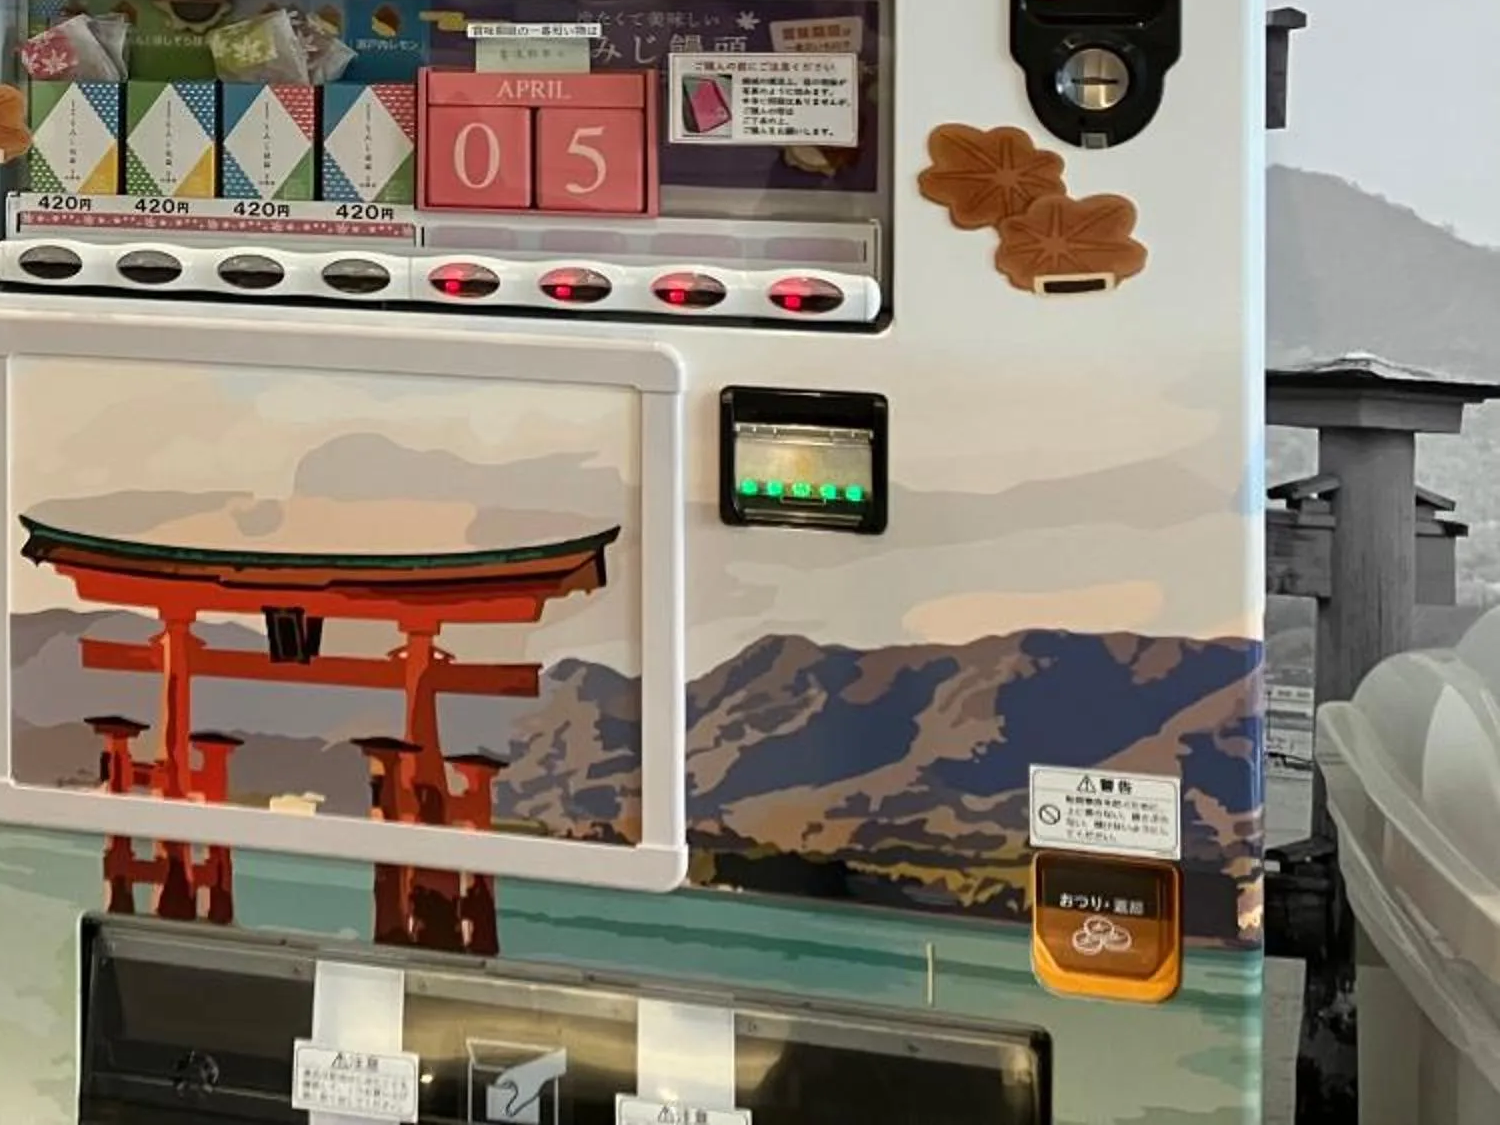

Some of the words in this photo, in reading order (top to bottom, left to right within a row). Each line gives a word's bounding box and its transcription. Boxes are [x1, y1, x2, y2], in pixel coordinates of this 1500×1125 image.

[496, 80, 573, 101] APRIL
[453, 122, 499, 190] 0
[563, 126, 608, 195] 5
[38, 196, 92, 212] 420円
[134, 198, 190, 215] 420円
[232, 202, 291, 218] 420円
[335, 204, 395, 220] 420円
